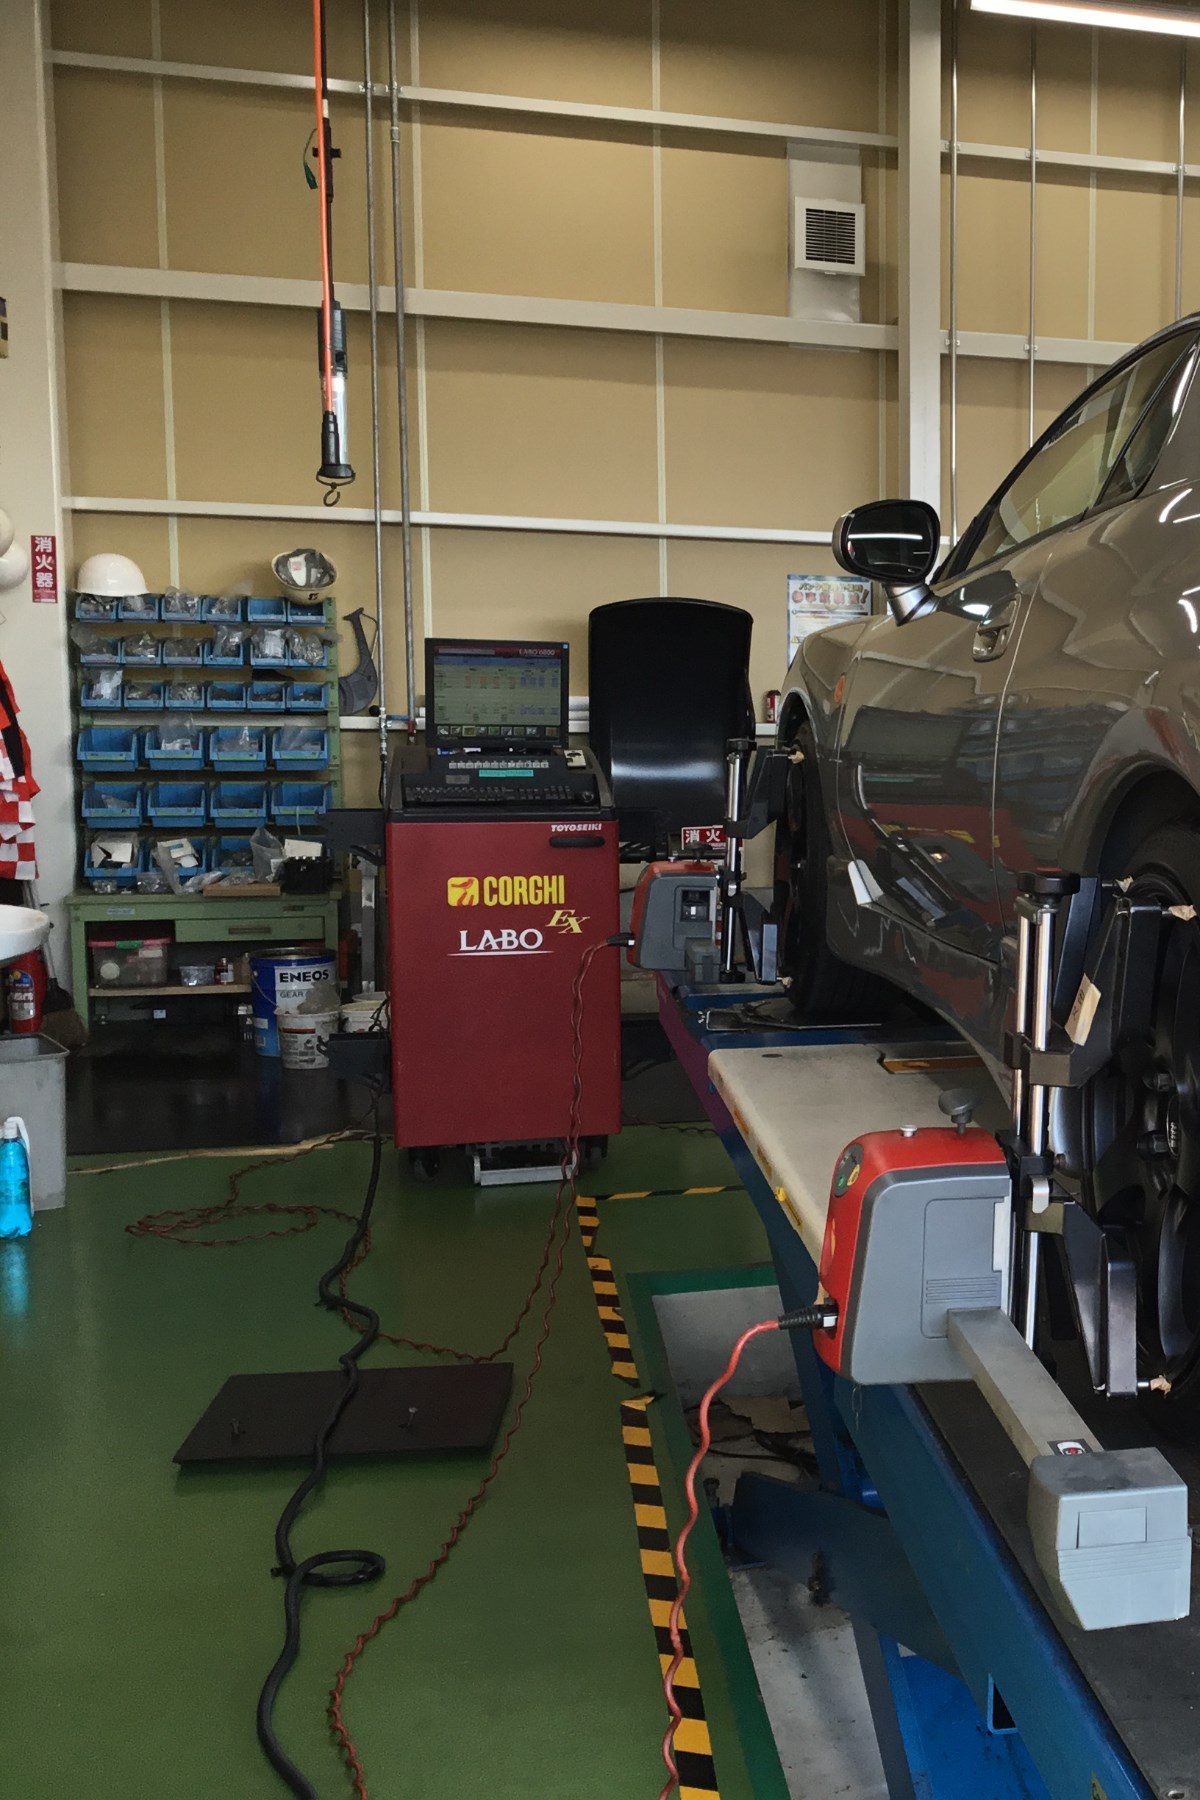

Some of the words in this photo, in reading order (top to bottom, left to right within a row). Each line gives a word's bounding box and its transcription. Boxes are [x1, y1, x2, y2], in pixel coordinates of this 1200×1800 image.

[35, 536, 54, 588] 消火器
[551, 823, 602, 832] TOYOSEIKI
[685, 829, 721, 843] 消火
[483, 874, 565, 907] CORGHI
[459, 928, 543, 951] LABO
[545, 909, 590, 934] EX
[280, 969, 329, 983] ENEOS
